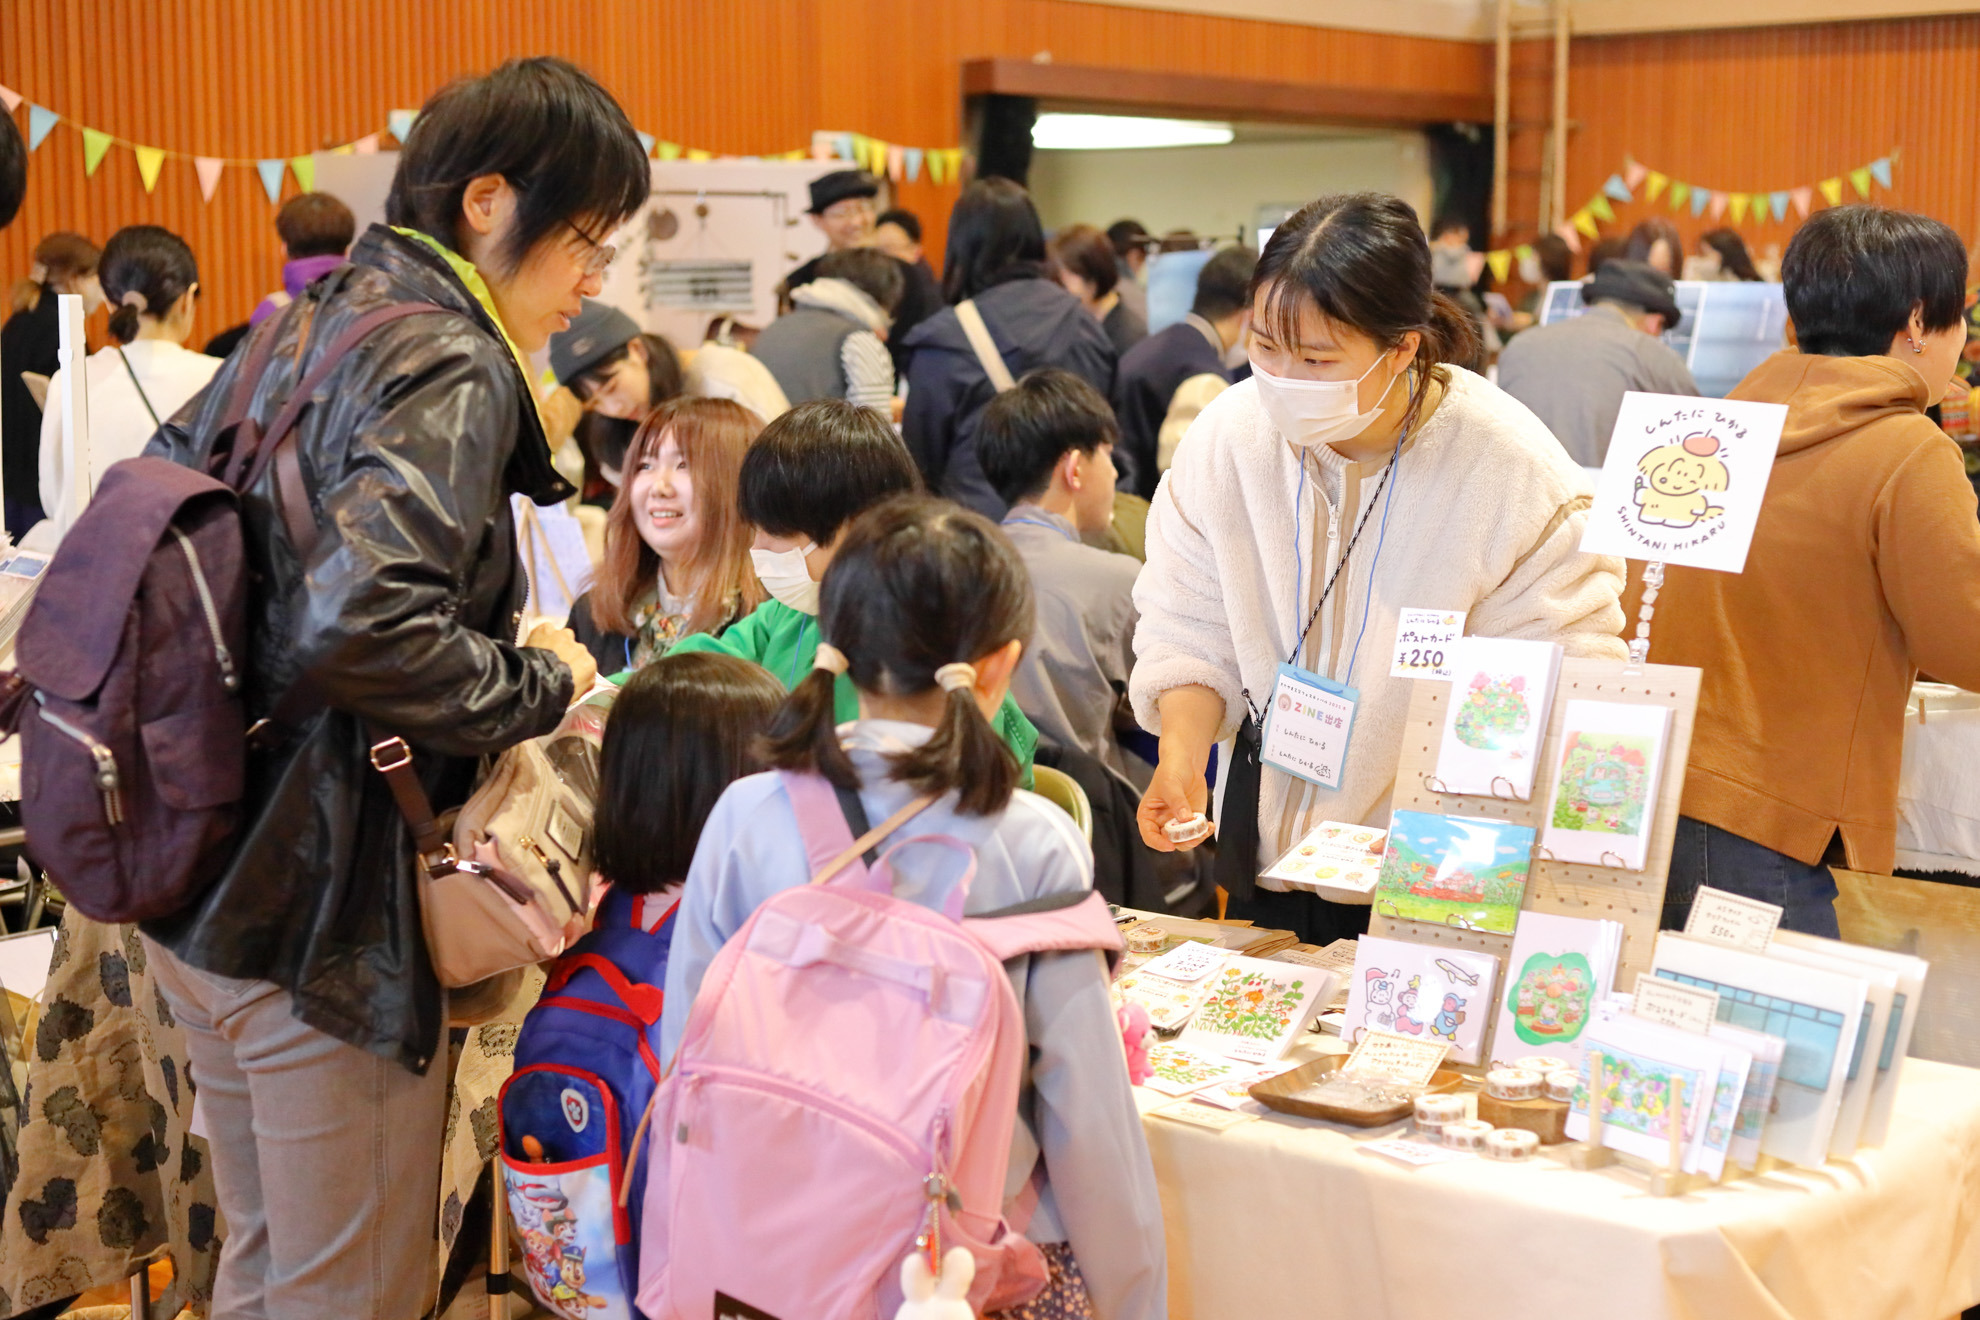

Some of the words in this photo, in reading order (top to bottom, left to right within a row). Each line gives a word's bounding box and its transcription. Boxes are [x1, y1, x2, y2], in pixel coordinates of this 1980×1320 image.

[1645, 409, 1705, 434] しんたに
[1617, 506, 1667, 550] SHINTANI
[1673, 521, 1726, 550] HIKARU
[1399, 631, 1456, 644] ポストカード
[1397, 648, 1444, 668] ¥250
